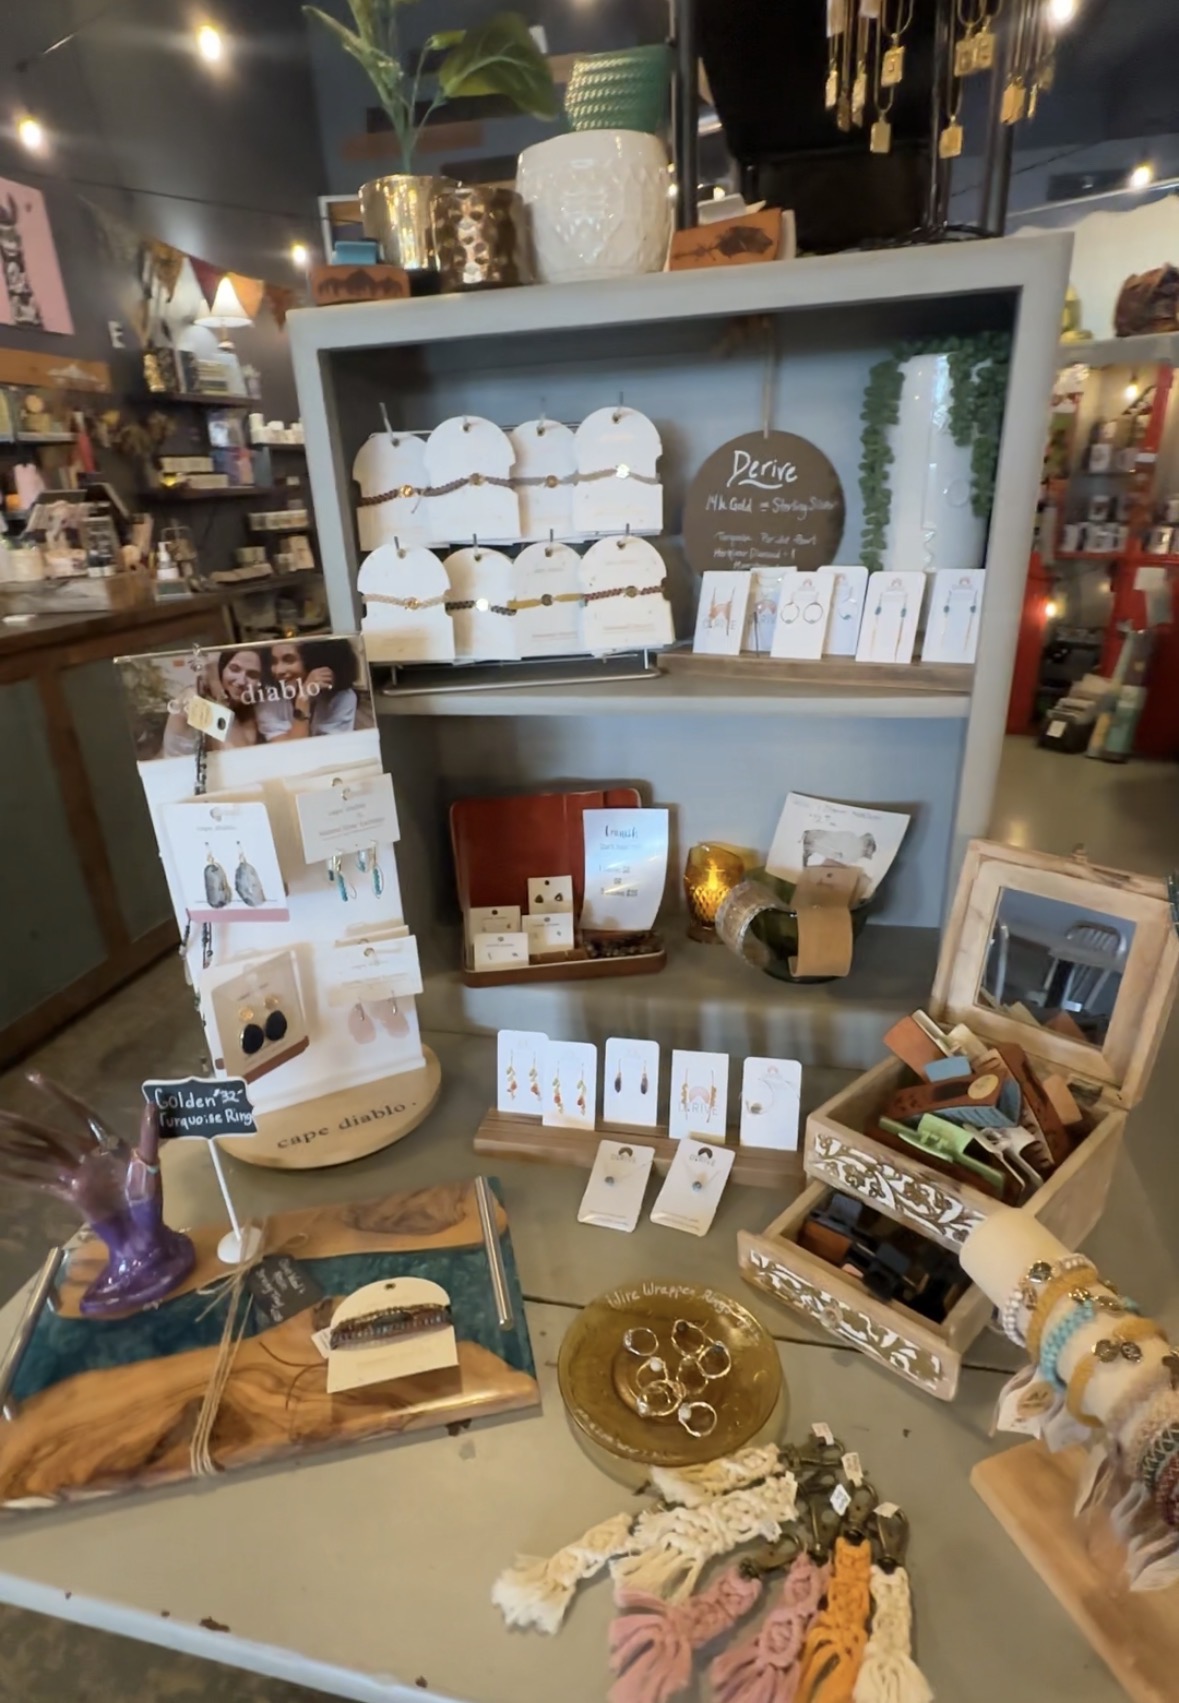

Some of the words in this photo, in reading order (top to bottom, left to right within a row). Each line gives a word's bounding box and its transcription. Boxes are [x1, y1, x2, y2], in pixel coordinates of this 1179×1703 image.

[726, 450, 798, 487] Derive
[154, 1088, 216, 1109] Golden
[225, 1108, 253, 1126] Ring
[276, 1127, 329, 1149] cape
[605, 1290, 640, 1309] Wire
